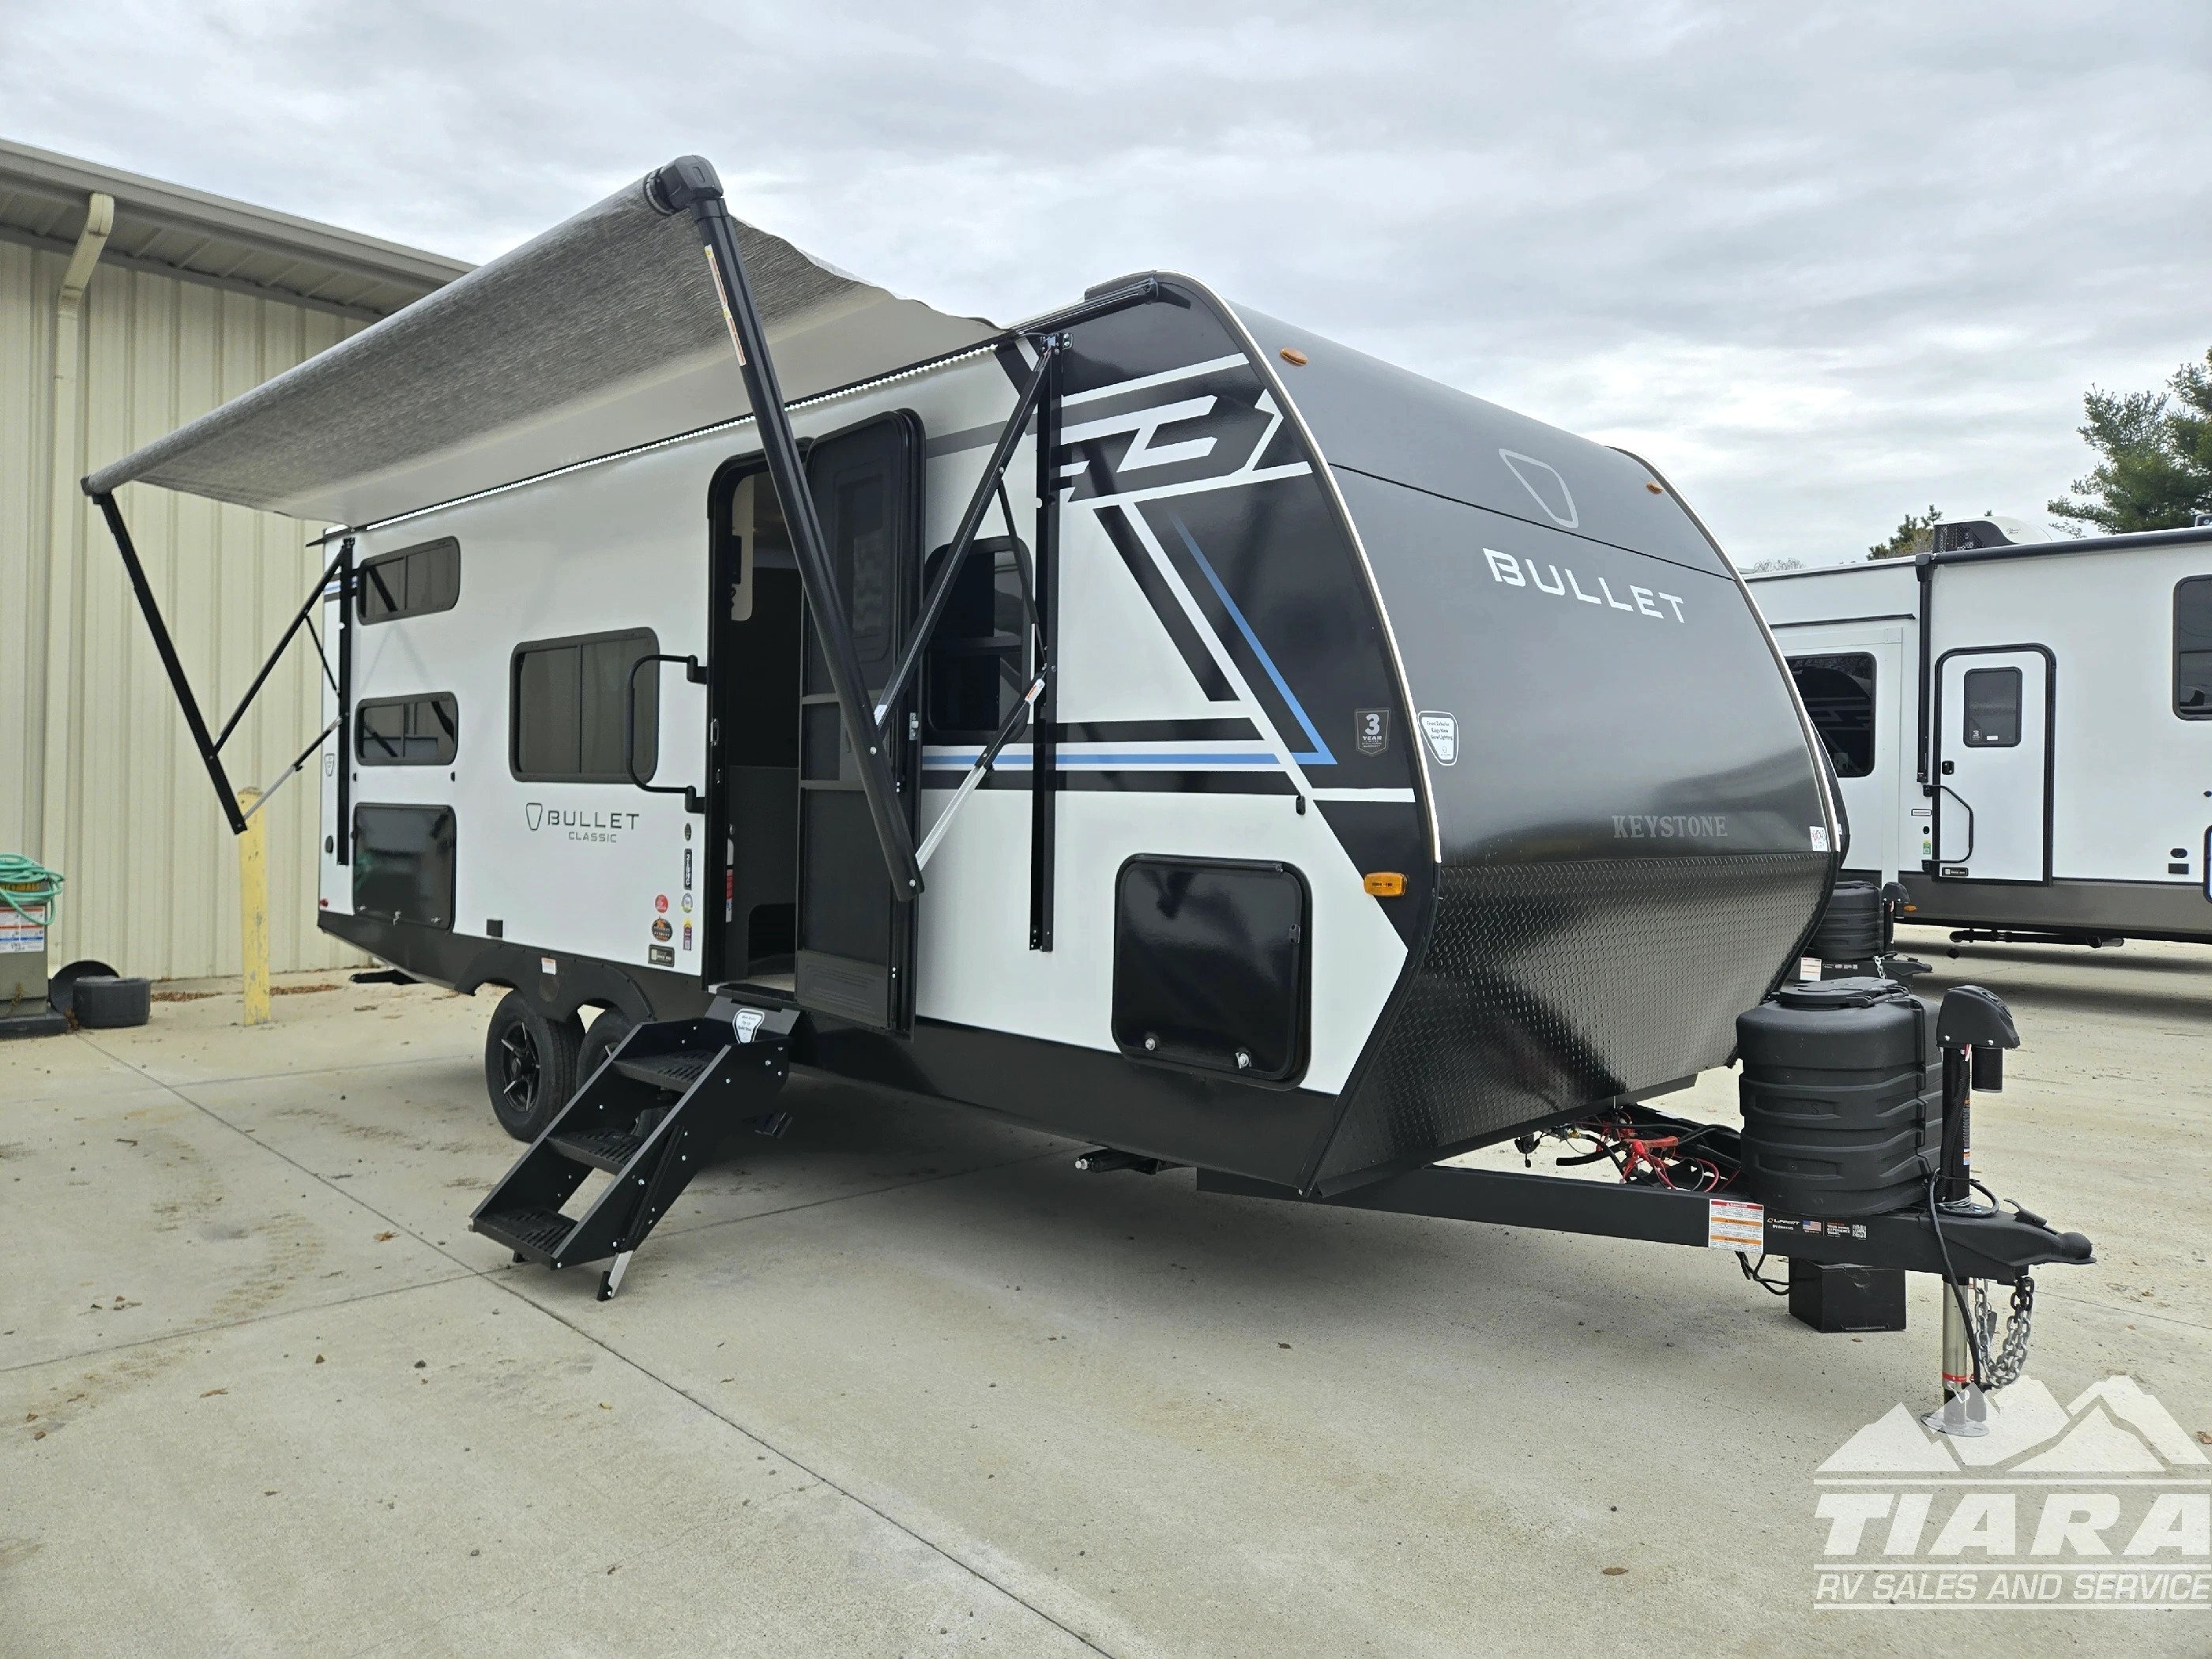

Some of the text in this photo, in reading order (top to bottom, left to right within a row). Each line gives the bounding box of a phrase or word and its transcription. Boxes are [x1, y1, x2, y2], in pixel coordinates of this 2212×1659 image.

[1482, 547, 1685, 623] BULLET
[1364, 713, 1380, 735] 3
[547, 809, 640, 830] BULLET
[1612, 814, 1729, 838] KEYSTONE
[568, 831, 617, 843] CLASSIC
